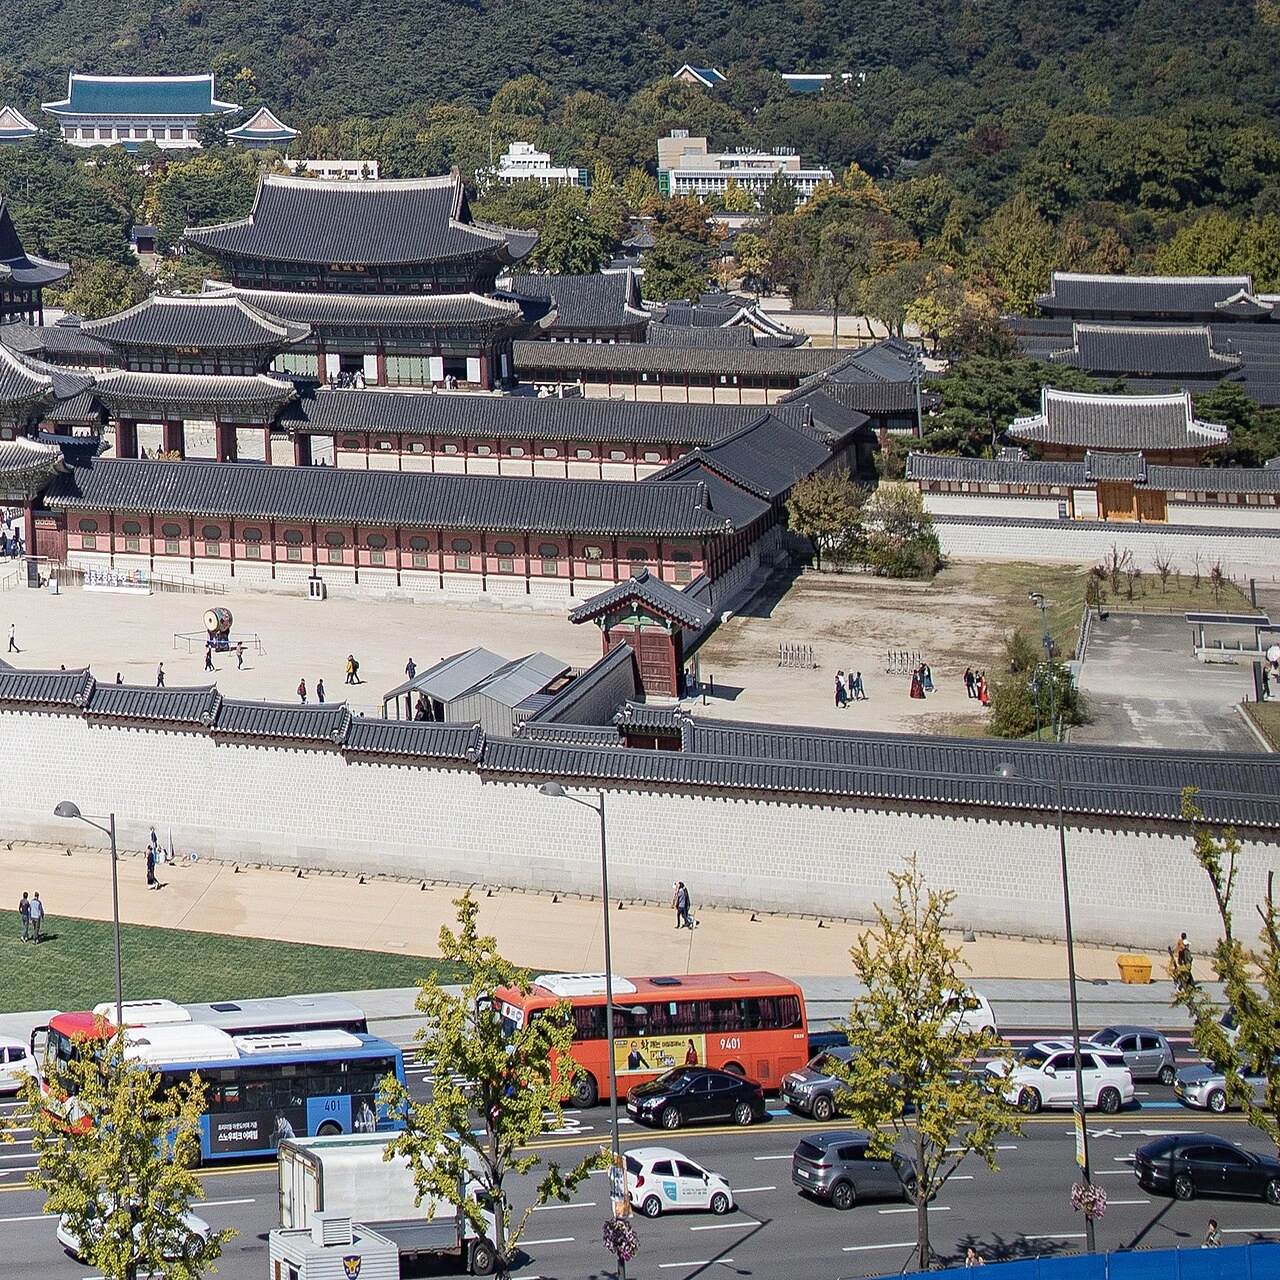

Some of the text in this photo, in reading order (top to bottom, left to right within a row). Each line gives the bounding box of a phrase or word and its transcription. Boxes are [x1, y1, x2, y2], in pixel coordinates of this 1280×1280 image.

[720, 1037, 740, 1050] 9401
[325, 1100, 340, 1111] 401
[218, 1131, 242, 1141] 스노우피크
